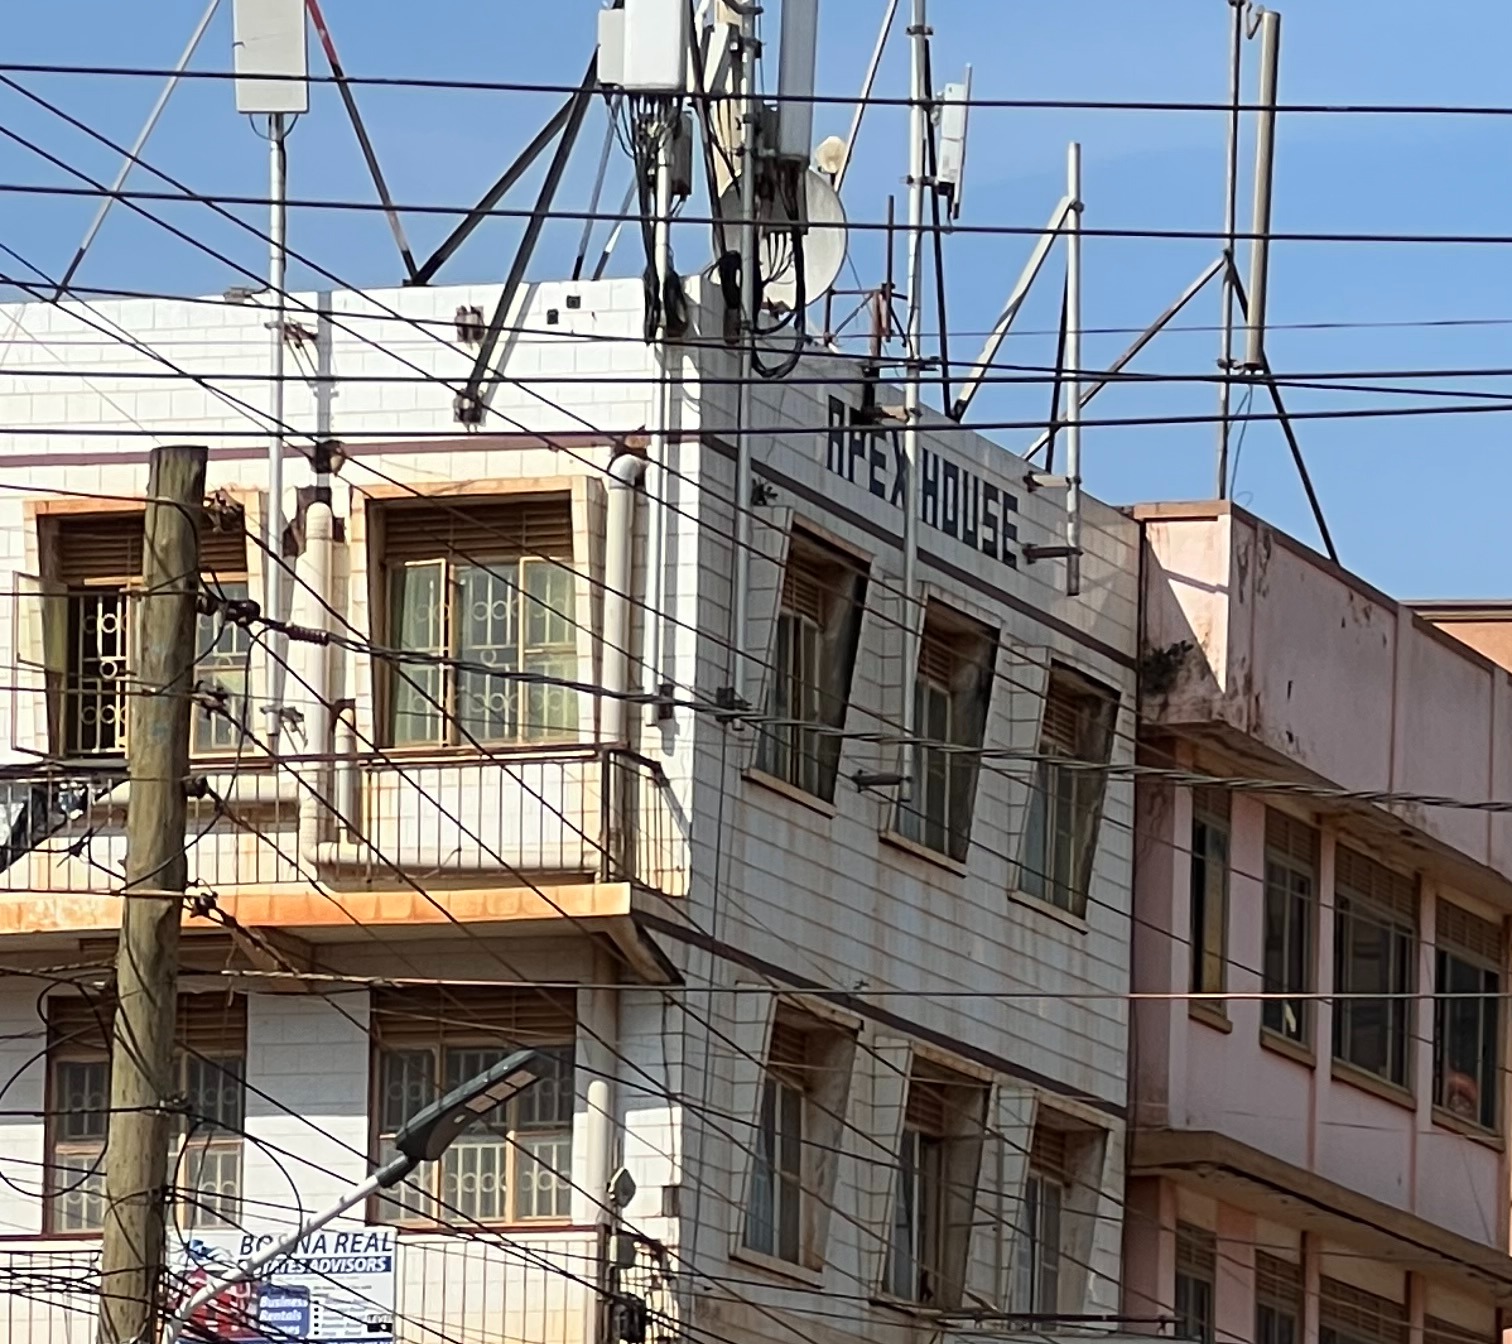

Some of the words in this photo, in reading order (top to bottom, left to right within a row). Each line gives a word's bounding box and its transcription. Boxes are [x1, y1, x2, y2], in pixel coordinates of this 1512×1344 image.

[922, 447, 1018, 570] HOUSE
[334, 1232, 393, 1251] REAL
[309, 1257, 387, 1273] ADVISORS
